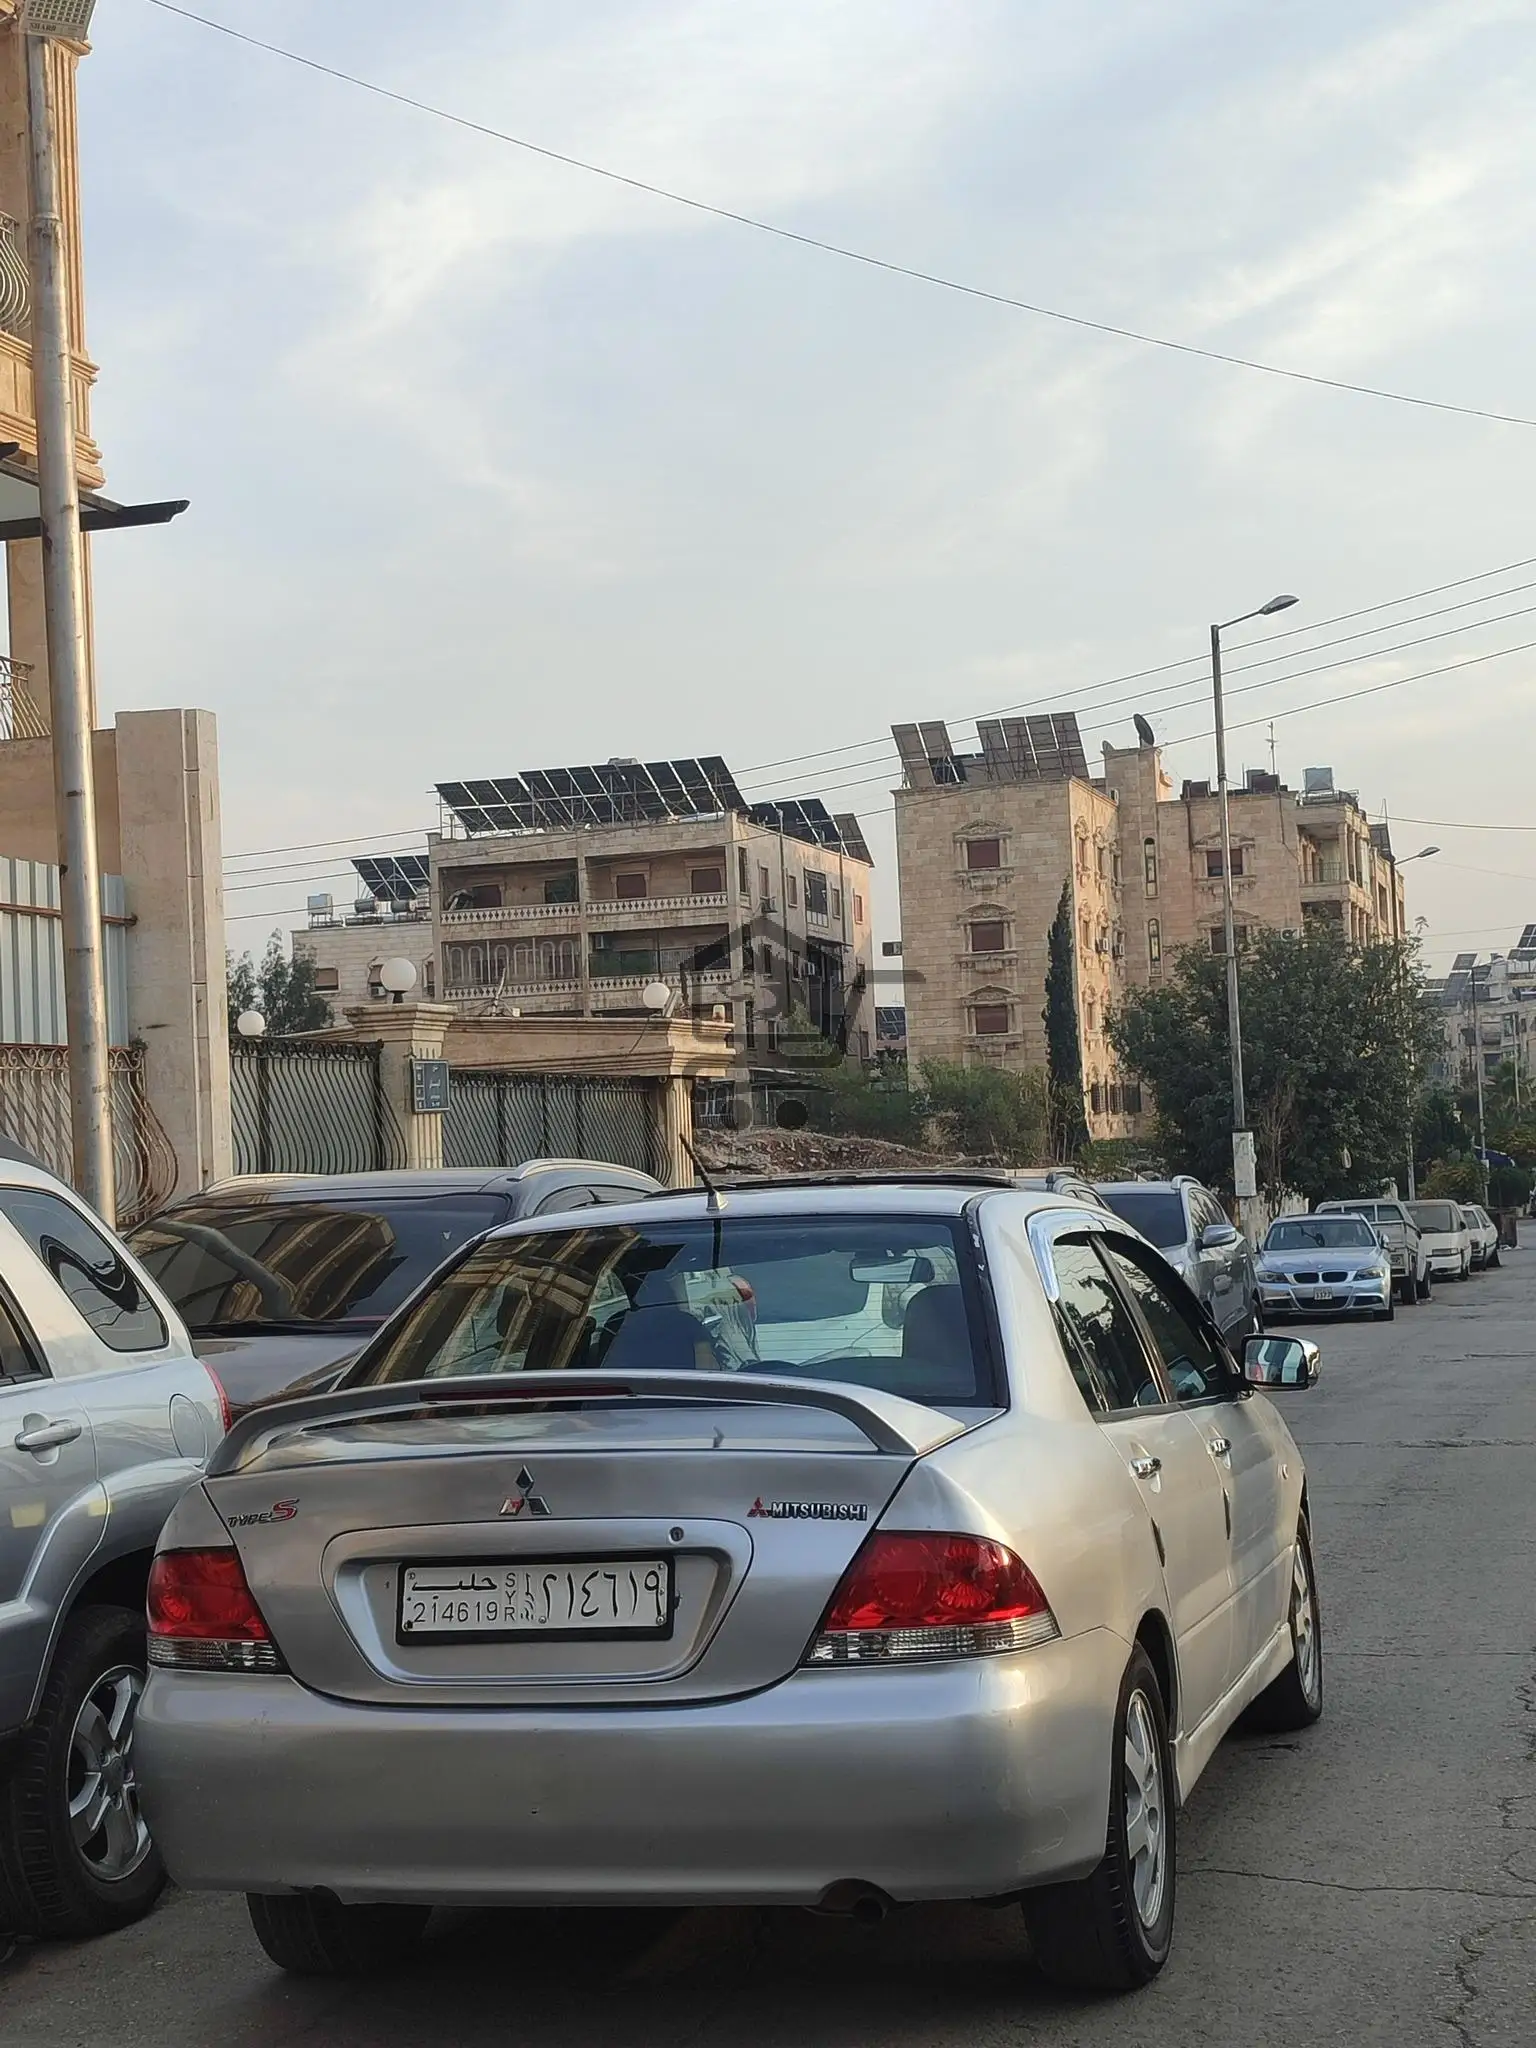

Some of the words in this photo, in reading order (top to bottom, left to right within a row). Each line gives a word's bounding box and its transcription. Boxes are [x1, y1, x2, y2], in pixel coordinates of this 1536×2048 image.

[228, 1512, 273, 1527] TYPE
[271, 1498, 300, 1523] S
[771, 1502, 868, 1521] MITSUBISHI
[411, 1573, 498, 1599] حلب
[542, 1570, 663, 1620] ٢١٤٦١٩
[413, 1601, 498, 1622] 214619
